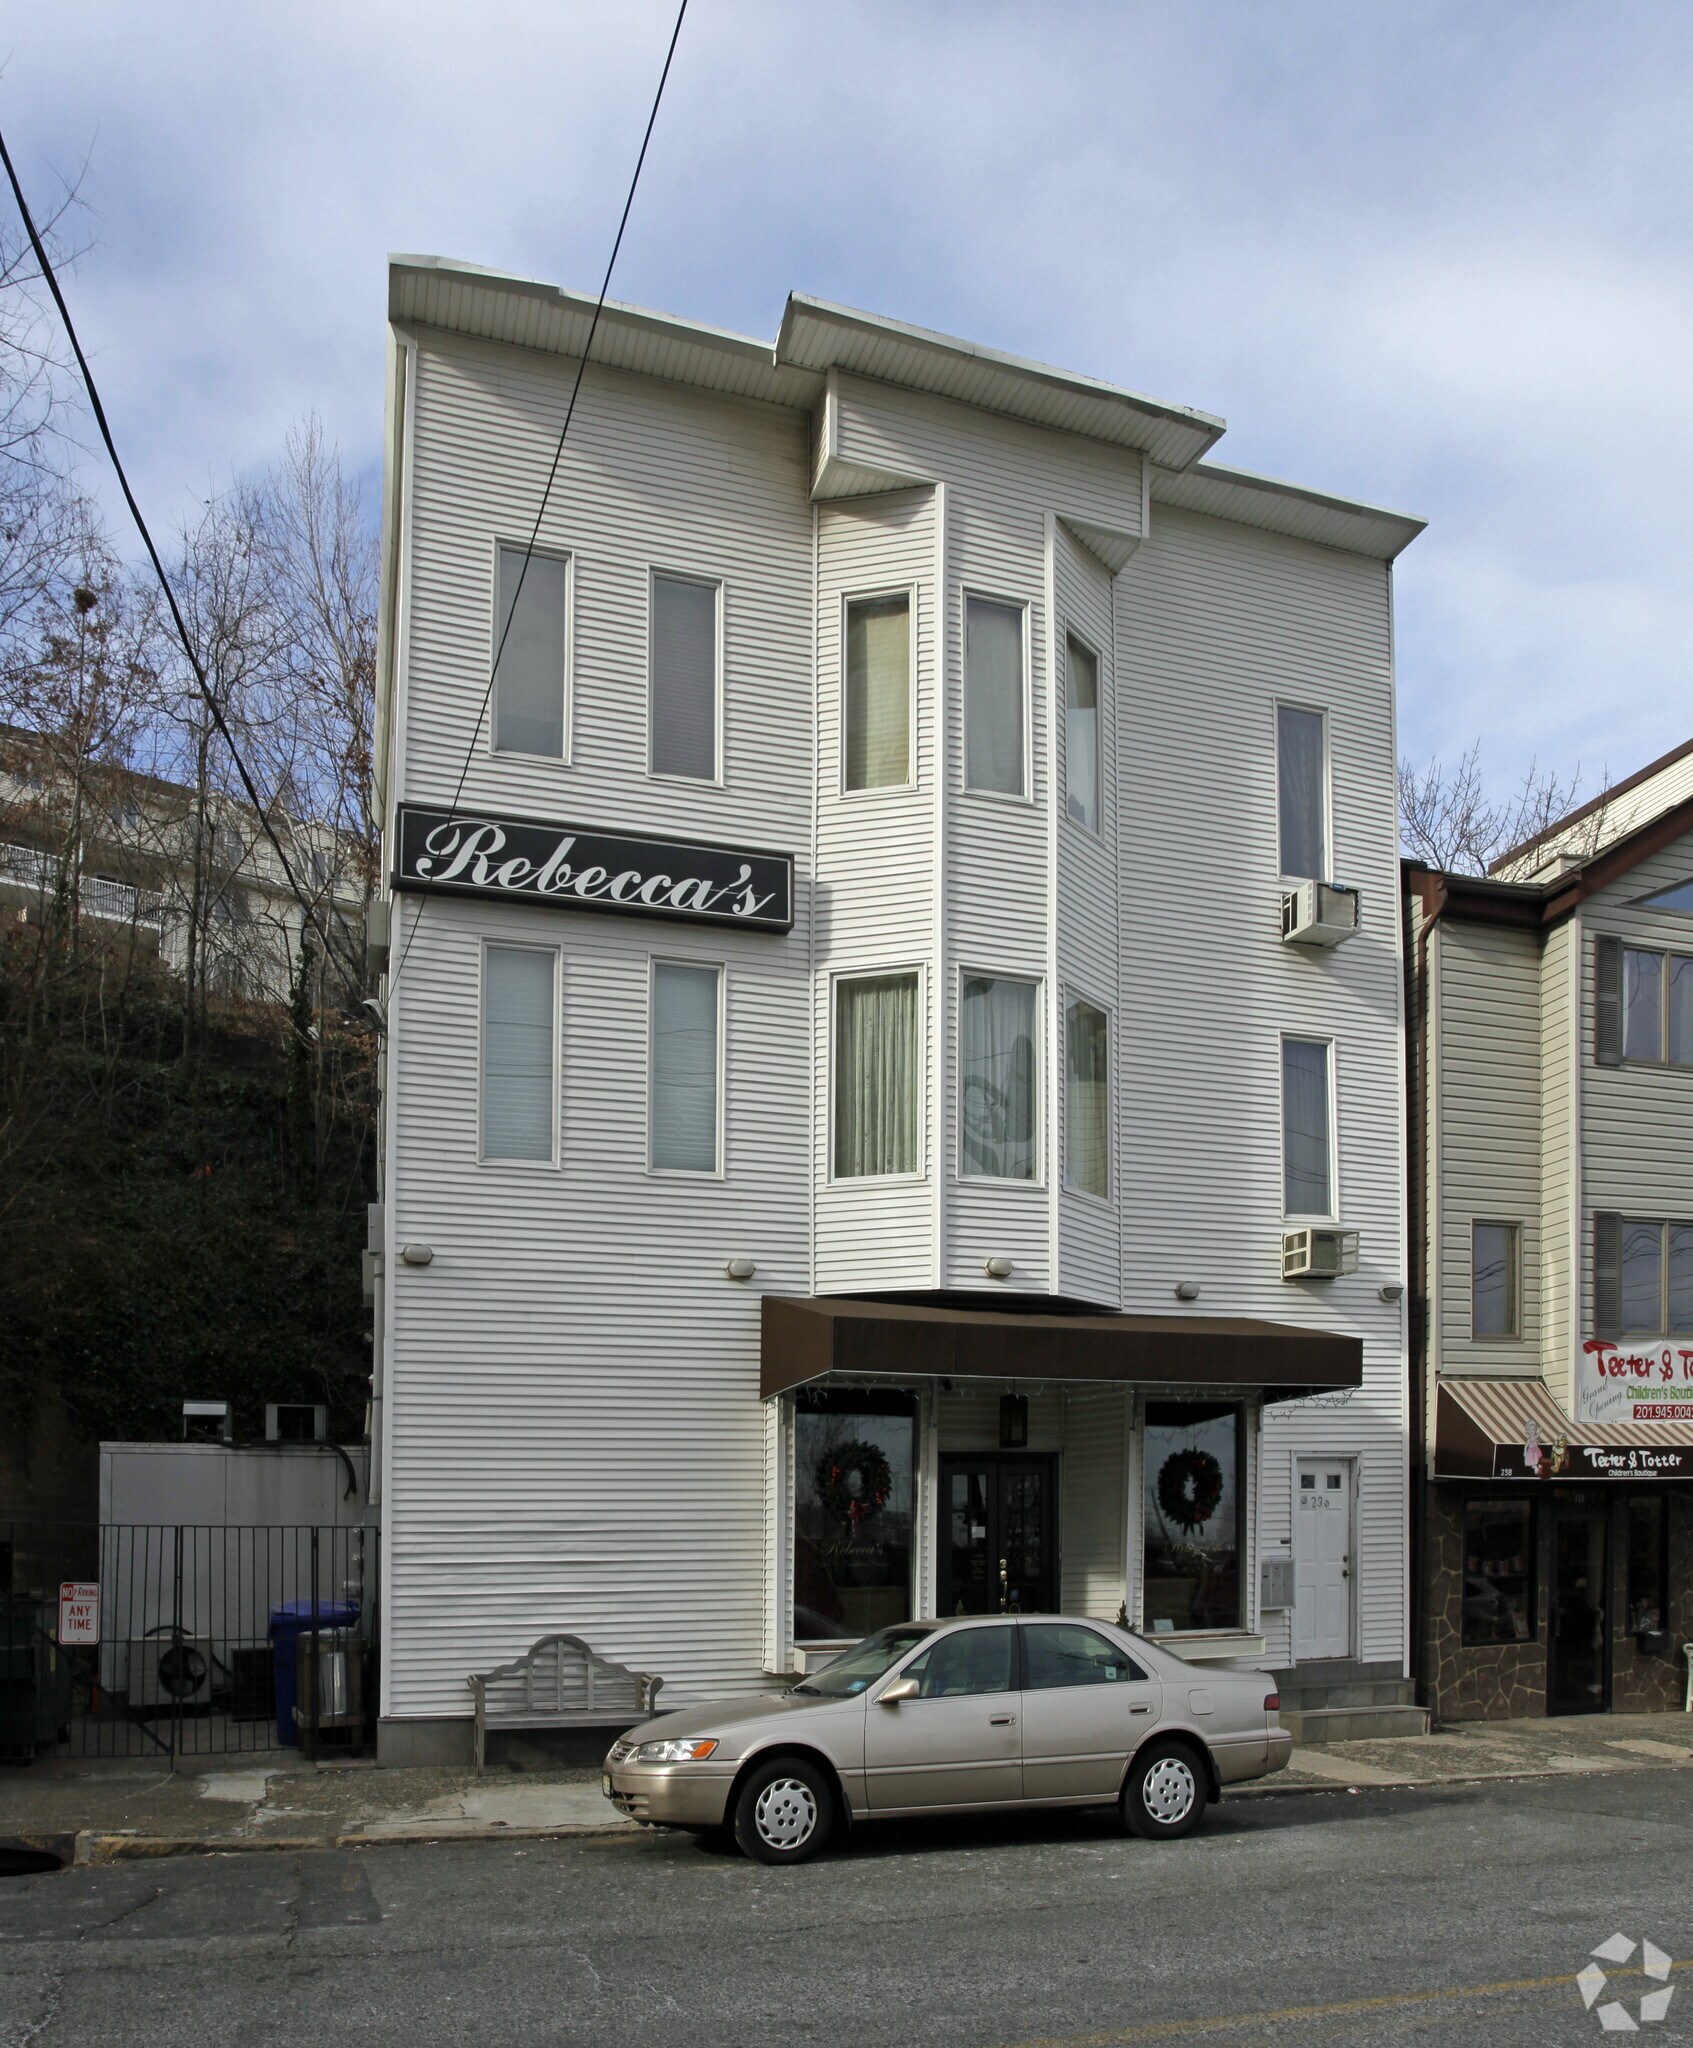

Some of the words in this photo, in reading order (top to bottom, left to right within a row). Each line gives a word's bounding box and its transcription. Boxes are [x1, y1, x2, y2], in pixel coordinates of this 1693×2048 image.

[415, 820, 776, 917] Rebecca's
[1583, 1340, 1655, 1378] Teeter
[1659, 1349, 1674, 1382] &
[1677, 1349, 1693, 1381] T
[1582, 1376, 1608, 1404] Grand
[1626, 1385, 1668, 1400] Children's
[1588, 1391, 1622, 1419] Opening
[1583, 1447, 1627, 1468] Teeter
[1627, 1450, 1638, 1469] &
[1638, 1450, 1682, 1468] Totter
[1500, 1468, 1512, 1477] 238
[1608, 1469, 1633, 1477] Children's
[1634, 1469, 1658, 1478] Boutique
[62, 1586, 73, 1598] NO
[73, 1588, 98, 1597] PARKING
[69, 1605, 91, 1616] ANY
[67, 1618, 92, 1630] TIME
